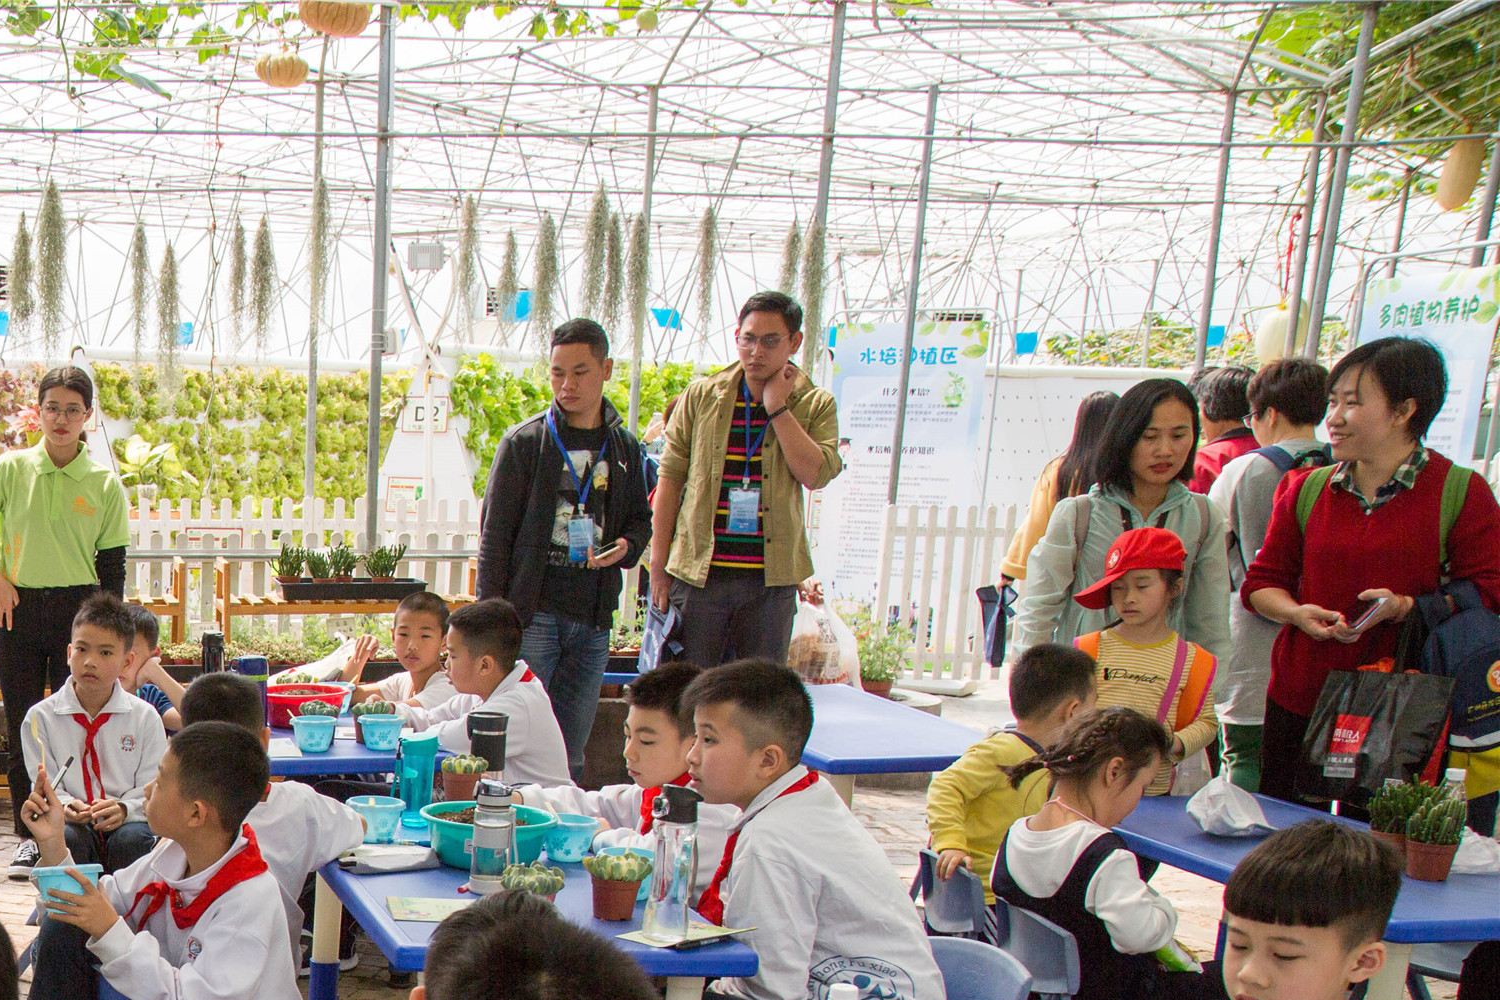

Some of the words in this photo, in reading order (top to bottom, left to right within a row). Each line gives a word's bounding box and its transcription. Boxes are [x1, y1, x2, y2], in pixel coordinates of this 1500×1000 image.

[1379, 295, 1480, 329] 多肉植物养护
[882, 387, 930, 397] 什么水培?
[415, 406, 439, 421] D2
[866, 445, 936, 455] 水培植养护知识
[869, 961, 898, 978] xiao
